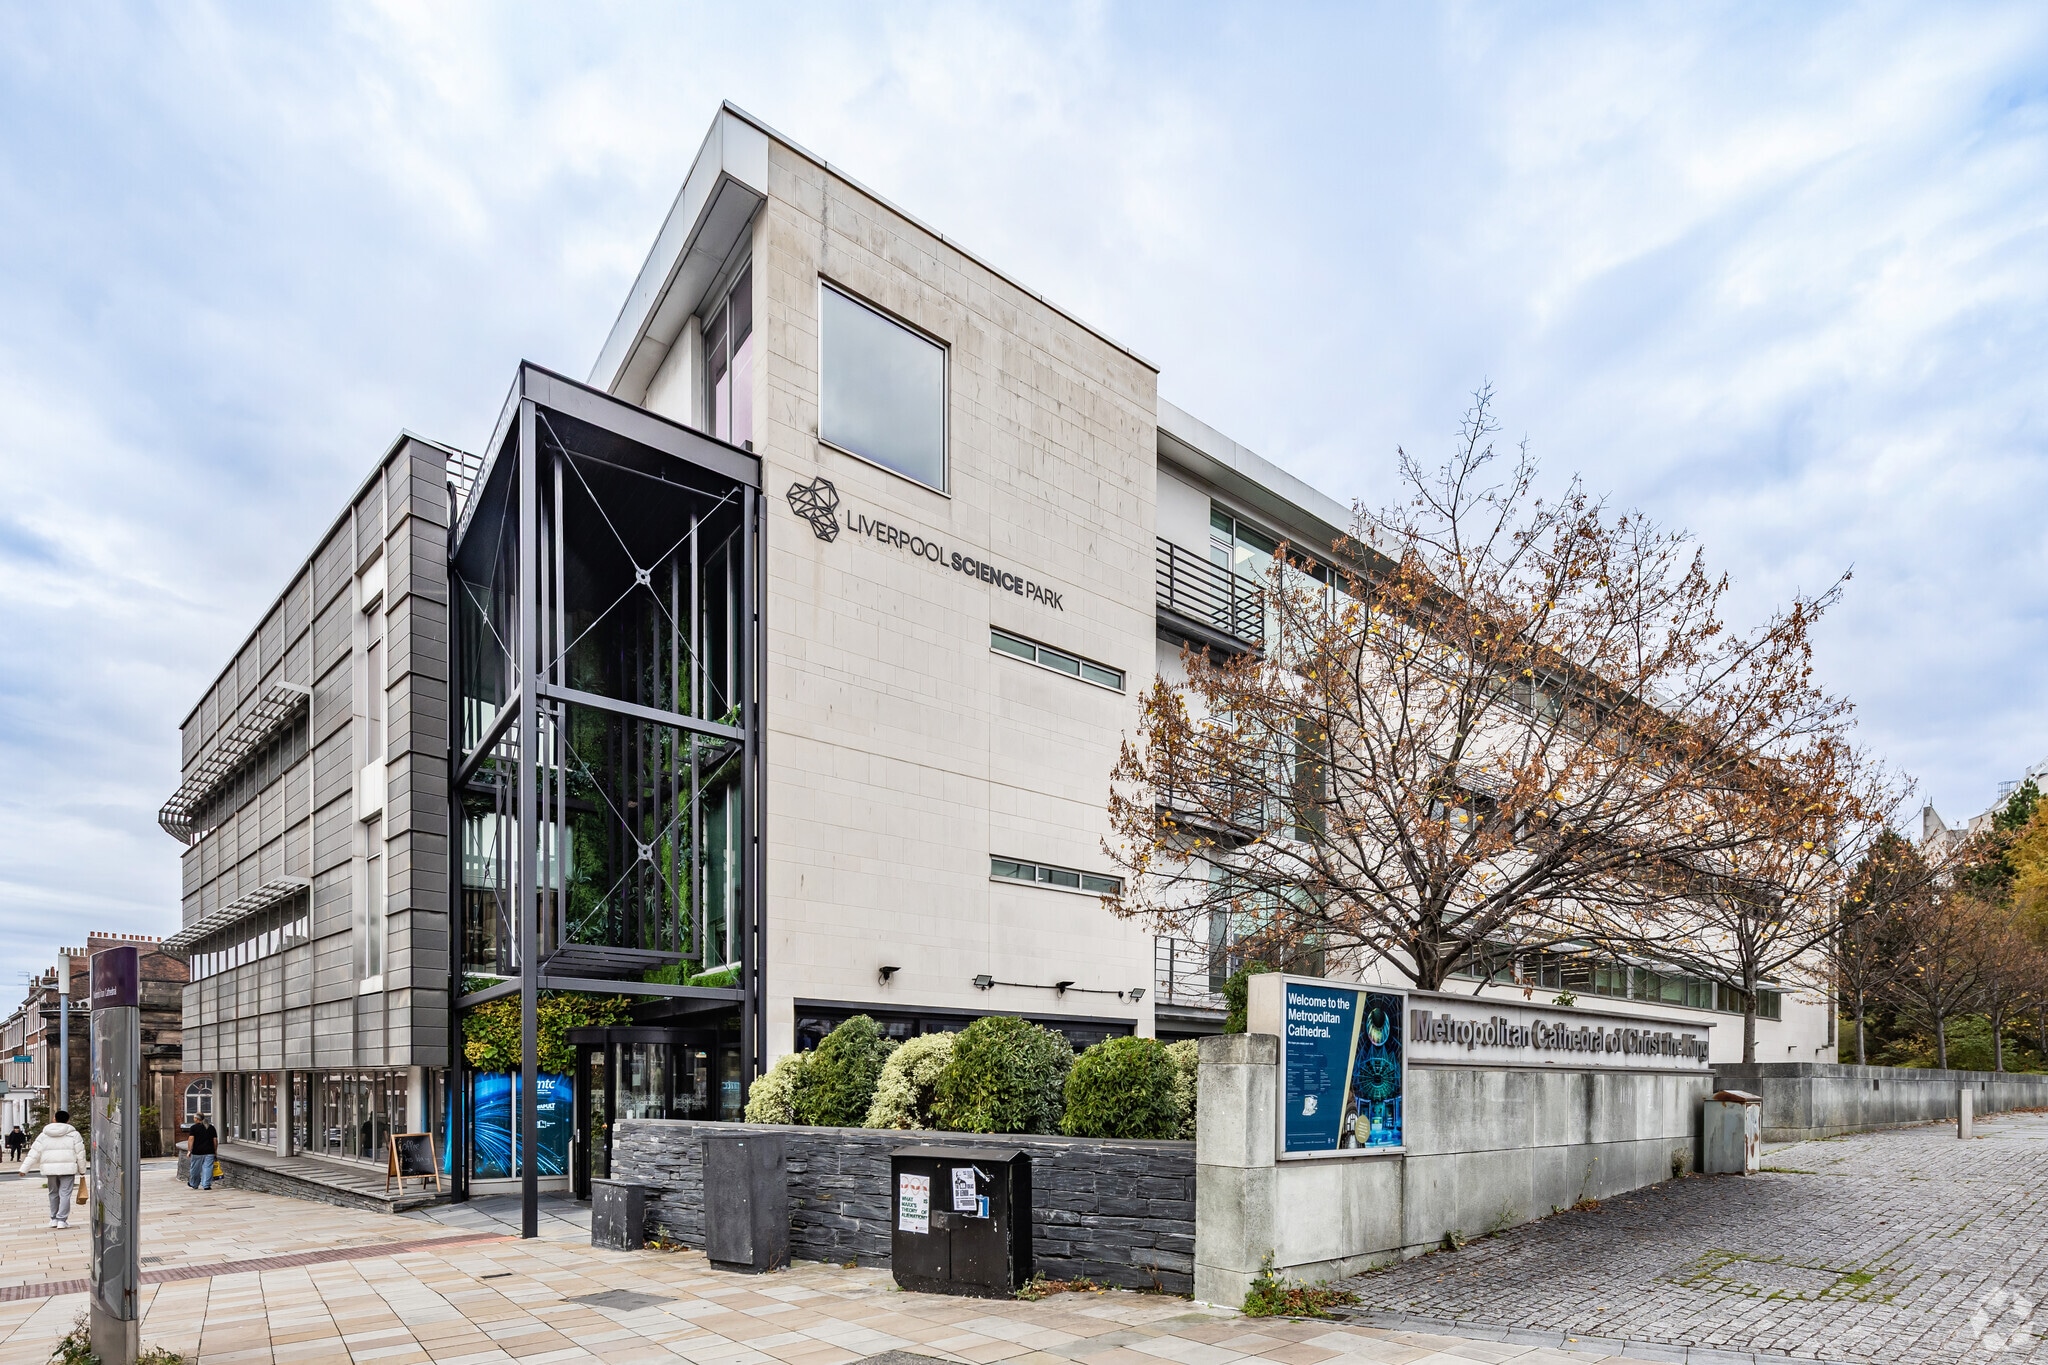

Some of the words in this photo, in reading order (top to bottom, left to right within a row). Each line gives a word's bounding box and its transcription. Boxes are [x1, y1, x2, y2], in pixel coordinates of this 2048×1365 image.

[847, 509, 950, 567] LIVERPOOL
[950, 552, 1024, 596] SCIENCE
[1026, 581, 1064, 612] PARK
[1288, 992, 1327, 1008] Welcome
[1328, 997, 1336, 1008] to
[1337, 997, 1350, 1010] the
[1288, 1008, 1340, 1024] Metropolitan
[1288, 1023, 1331, 1038] Cathedral.
[1411, 1010, 1530, 1051] Metropolitan
[1532, 1019, 1603, 1051] Cathedral
[1605, 1028, 1623, 1053] of
[1623, 1028, 1663, 1055] Christ
[1662, 1032, 1682, 1056] the
[1682, 1034, 1708, 1062] King
